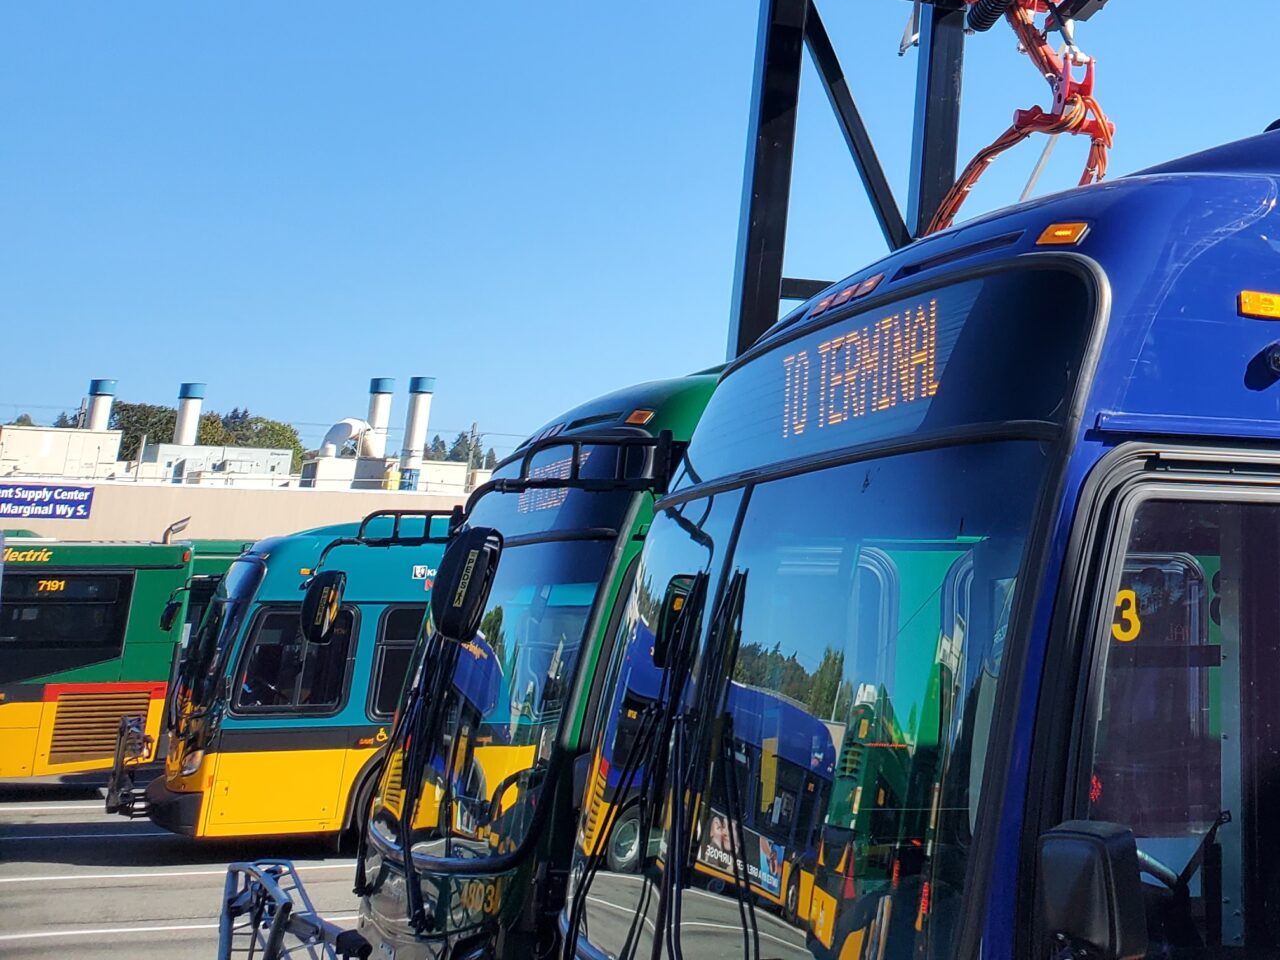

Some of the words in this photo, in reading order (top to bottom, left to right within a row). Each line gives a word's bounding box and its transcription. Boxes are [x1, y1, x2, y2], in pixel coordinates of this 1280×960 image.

[783, 351, 809, 438] TO
[818, 299, 938, 428] TERMINAL
[15, 487, 52, 501] Supply
[54, 488, 90, 500] Center
[0, 503, 53, 516] Marginal
[55, 504, 75, 517] Wy
[76, 505, 87, 515] S.
[460, 558, 475, 589] PEDS
[38, 580, 65, 591] 7191
